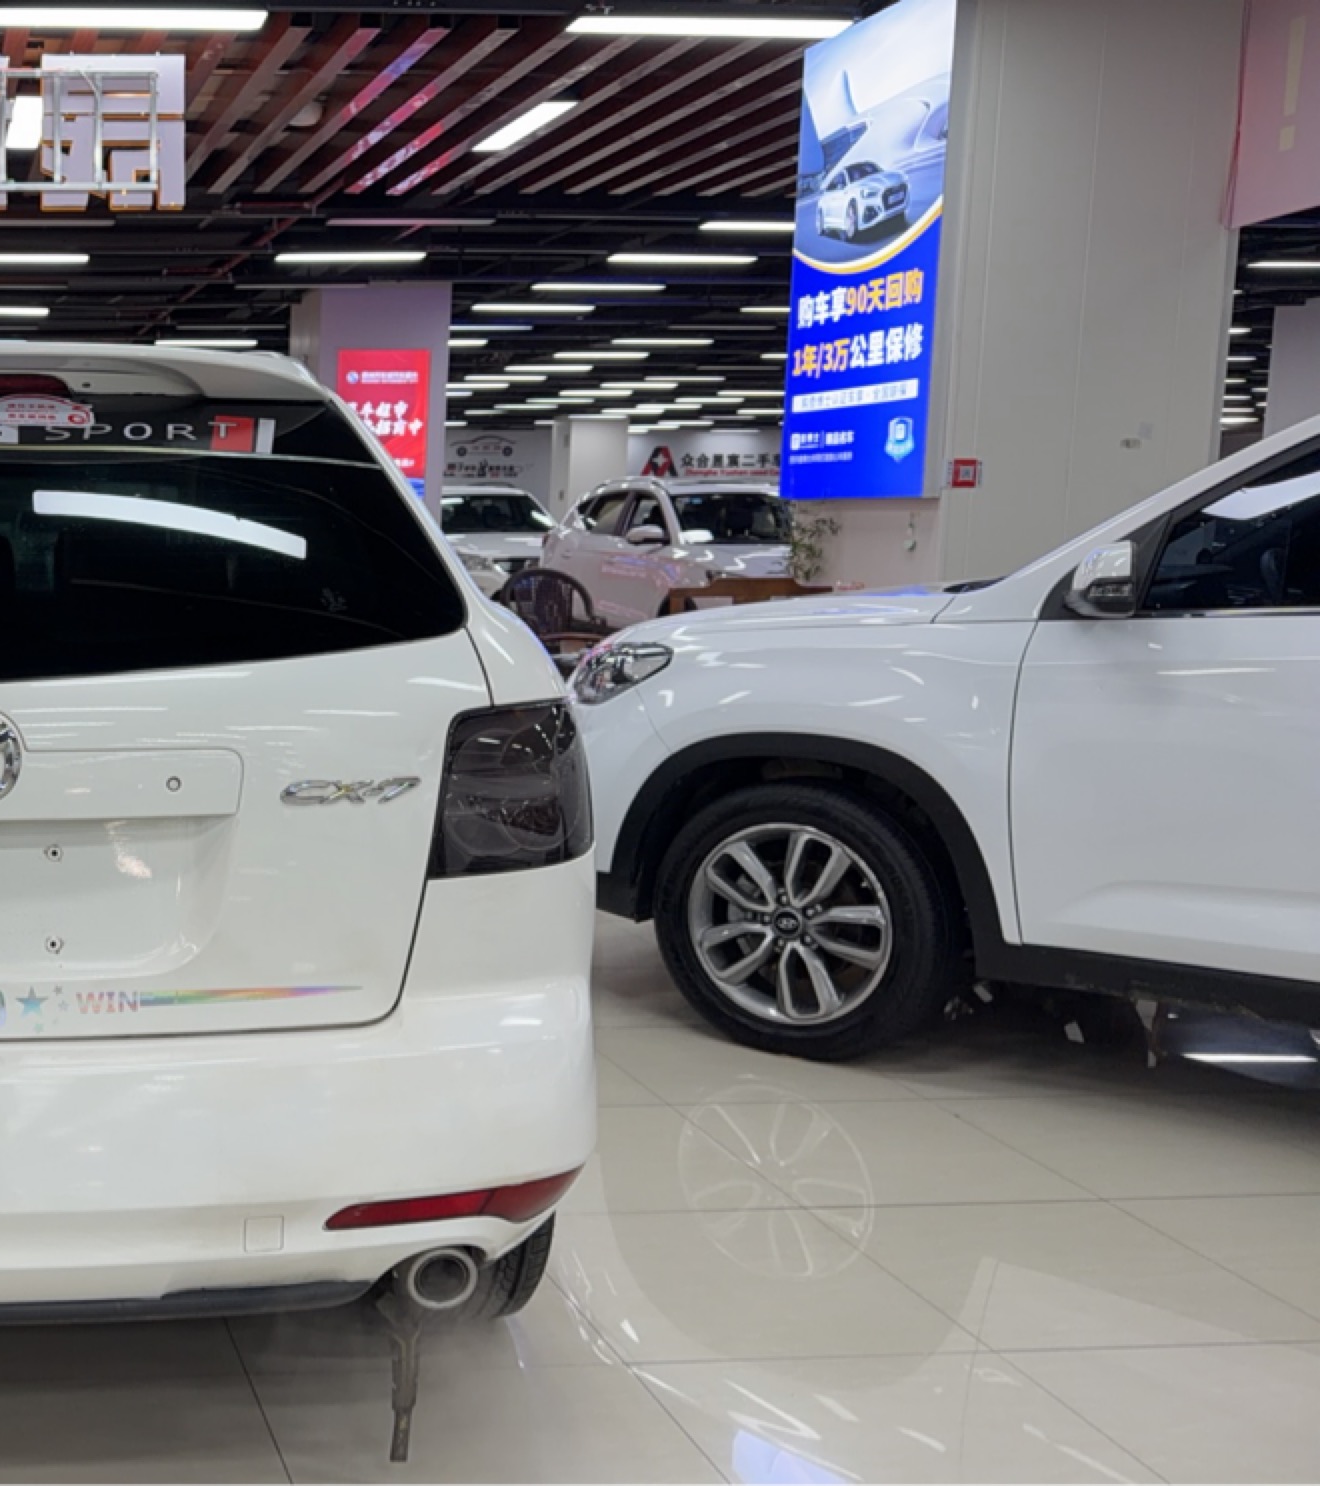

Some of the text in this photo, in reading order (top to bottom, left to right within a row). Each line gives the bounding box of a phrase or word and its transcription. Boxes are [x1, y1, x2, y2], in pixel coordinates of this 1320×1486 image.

[796, 268, 925, 328] 购车享90天回购
[791, 322, 924, 380] 1年/3万公里保修
[45, 421, 236, 441] SPORT
[280, 776, 421, 806] CX-7
[76, 990, 139, 1014] WIN
